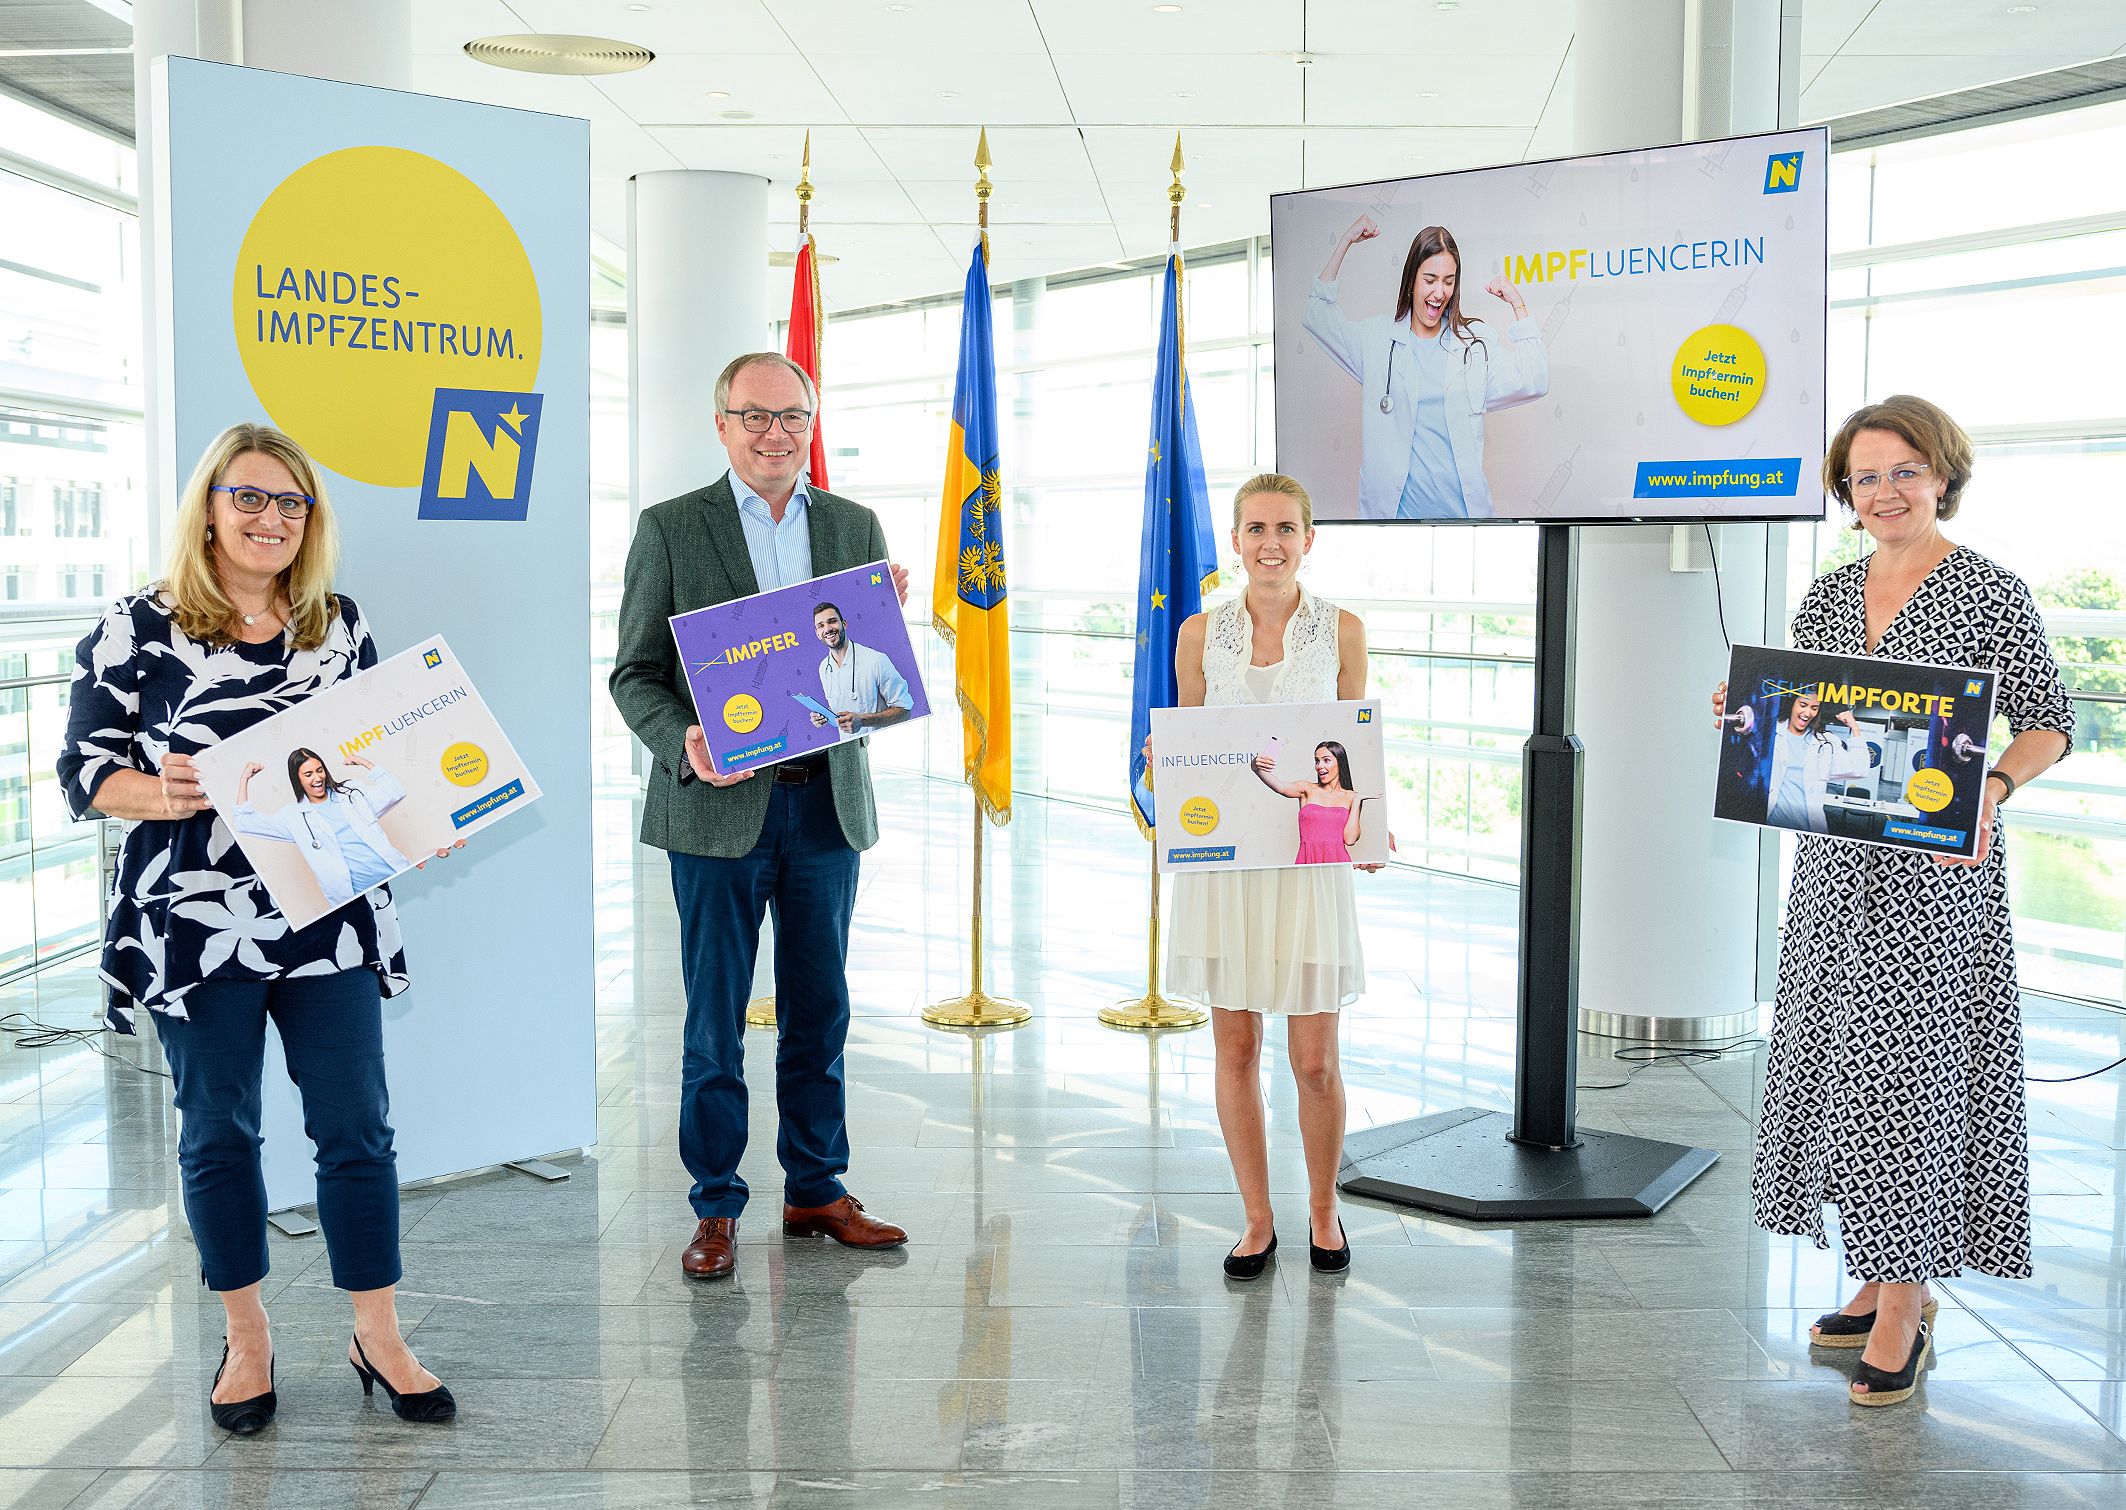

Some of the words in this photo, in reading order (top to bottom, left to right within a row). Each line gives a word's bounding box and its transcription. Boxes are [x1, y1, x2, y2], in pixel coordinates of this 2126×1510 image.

[256, 264, 420, 309] LANDES-
[256, 309, 525, 361] IMPFZENTRUM.
[1703, 350, 1738, 365] Jetzt
[1681, 364, 1754, 387] Impftermin
[1688, 383, 1740, 402] buchen!
[1648, 470, 1784, 490] www.impfung.at
[724, 631, 800, 665] IMPFER
[1816, 681, 1955, 718] IMPFORTE
[338, 685, 468, 759] IMPFLUENCERIN
[454, 753, 470, 762] Jetzt
[727, 741, 782, 763] www.impfung.at
[446, 757, 482, 773] Impftermin
[454, 766, 480, 778] buchen!
[457, 785, 518, 822] www.impfung.at
[1890, 825, 1958, 843] www.impfung.at
[1173, 850, 1230, 859] www.impfung.at
